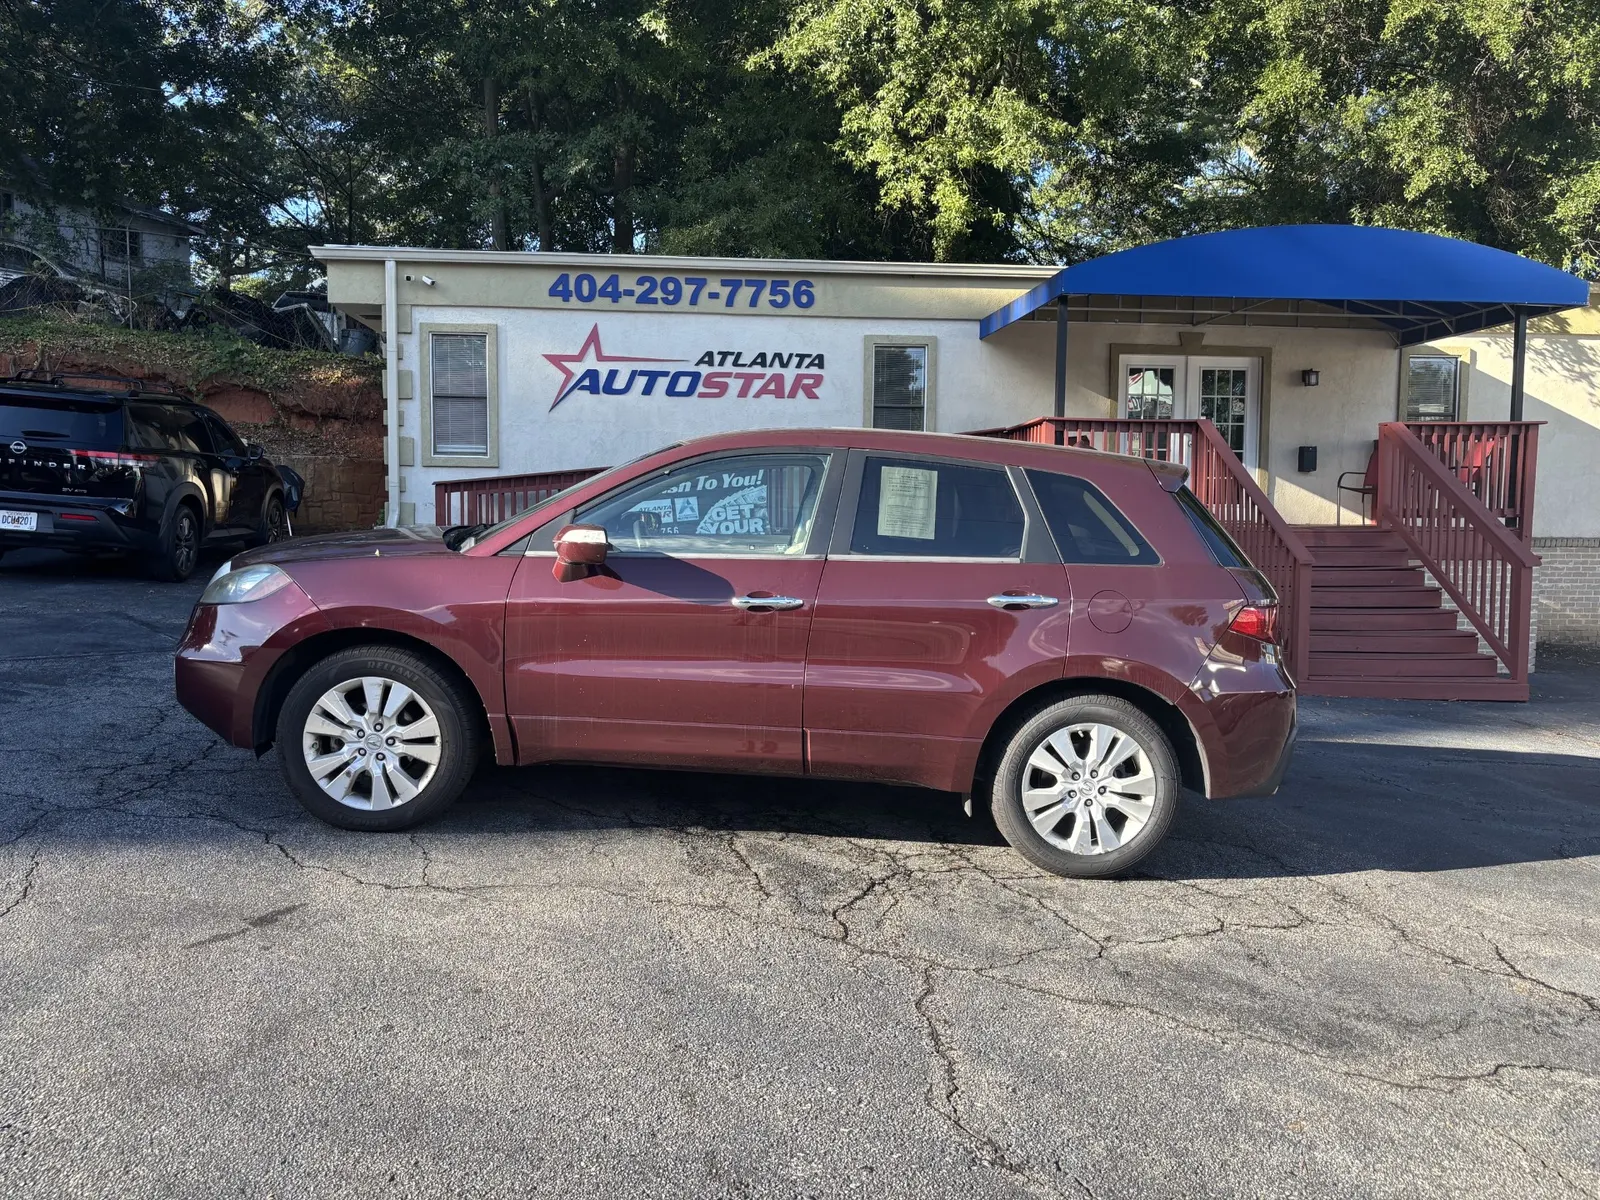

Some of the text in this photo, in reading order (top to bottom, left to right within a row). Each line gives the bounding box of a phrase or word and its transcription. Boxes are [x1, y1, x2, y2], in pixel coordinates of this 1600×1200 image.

[548, 273, 815, 309] 404-297-7756
[694, 350, 825, 370] ATLANTA
[563, 368, 824, 401] AUTOSTAR
[696, 475, 718, 491] To
[722, 469, 764, 488] You!
[711, 504, 754, 521] GET
[706, 518, 764, 535] YOUR
[367, 660, 420, 682] RELIANT
